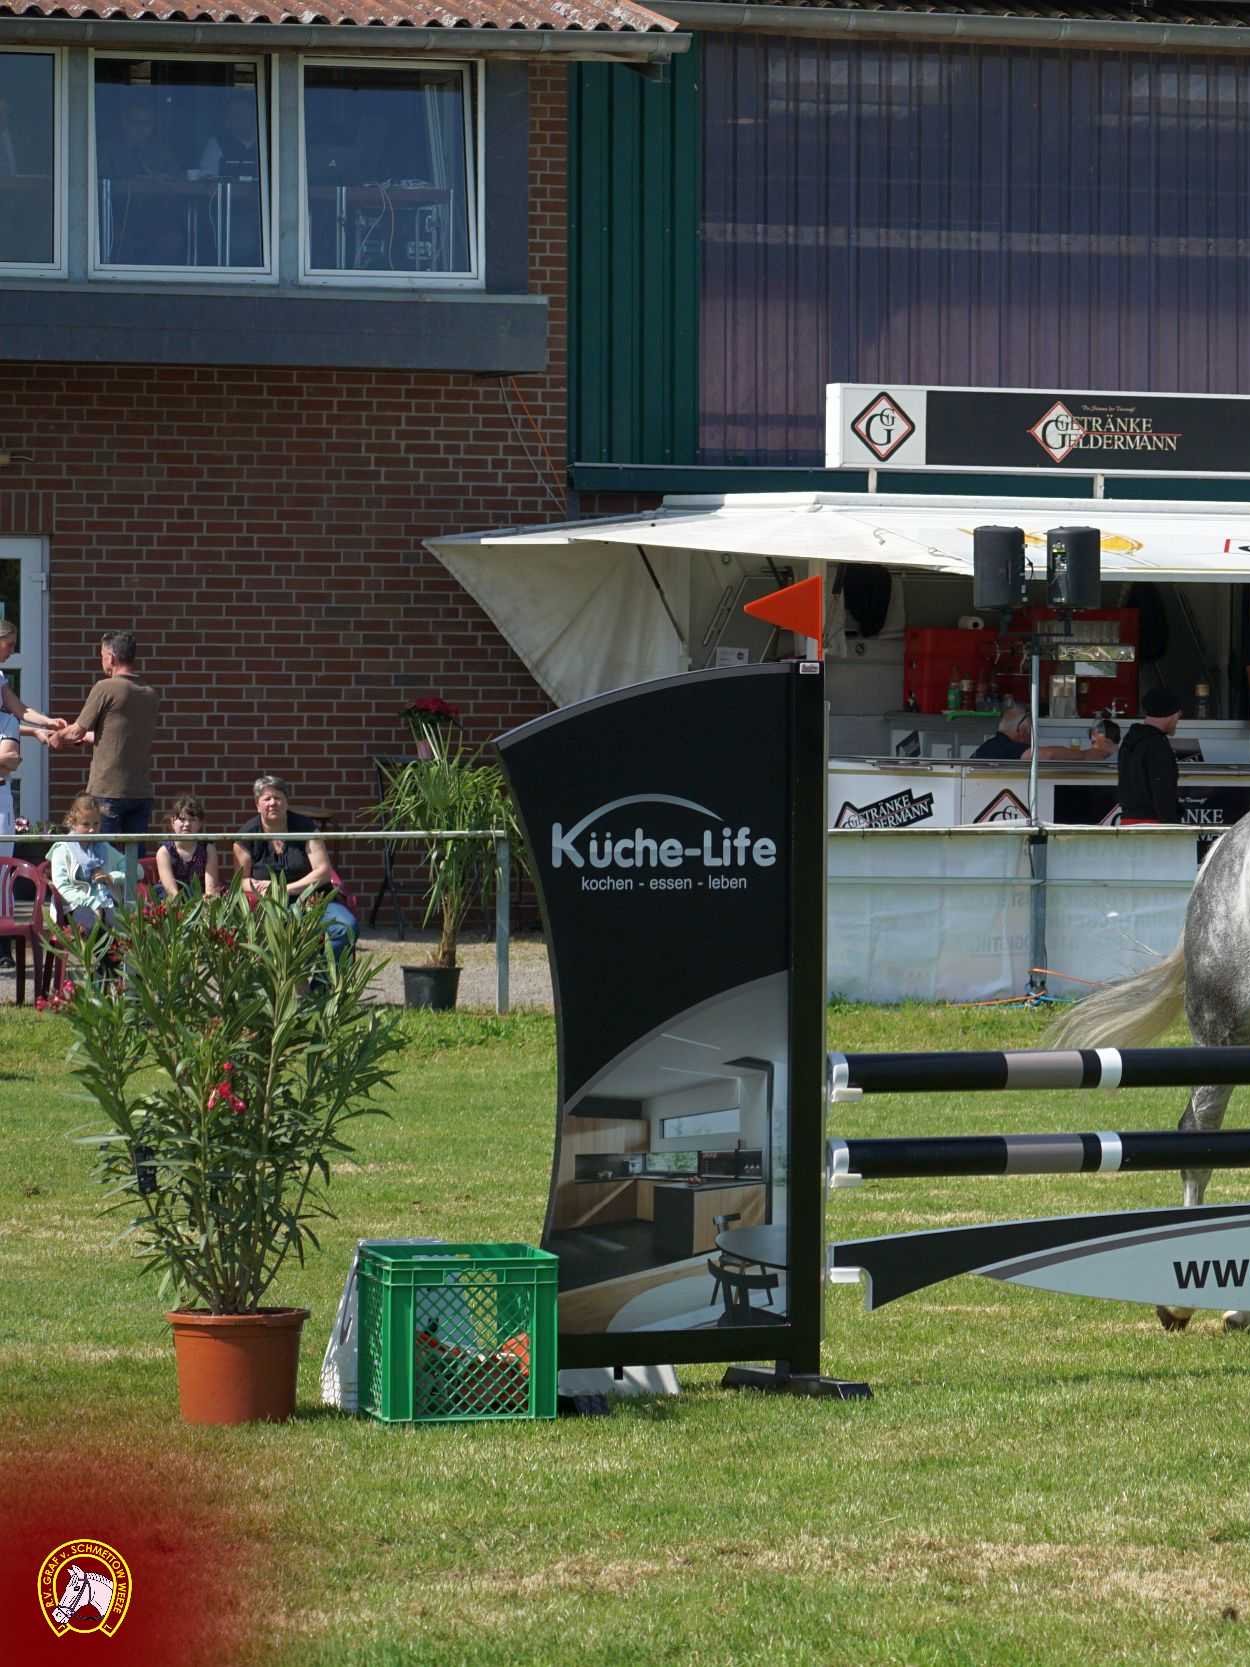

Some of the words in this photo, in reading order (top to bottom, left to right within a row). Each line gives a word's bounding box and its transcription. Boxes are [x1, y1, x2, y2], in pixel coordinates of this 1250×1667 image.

[1041, 419, 1177, 451] GELDERMANN
[1055, 413, 1153, 433] GETRÄNKE
[552, 822, 777, 869] Küche-Life
[581, 876, 633, 891] kochen
[650, 877, 692, 890] essen
[708, 875, 747, 890] leben
